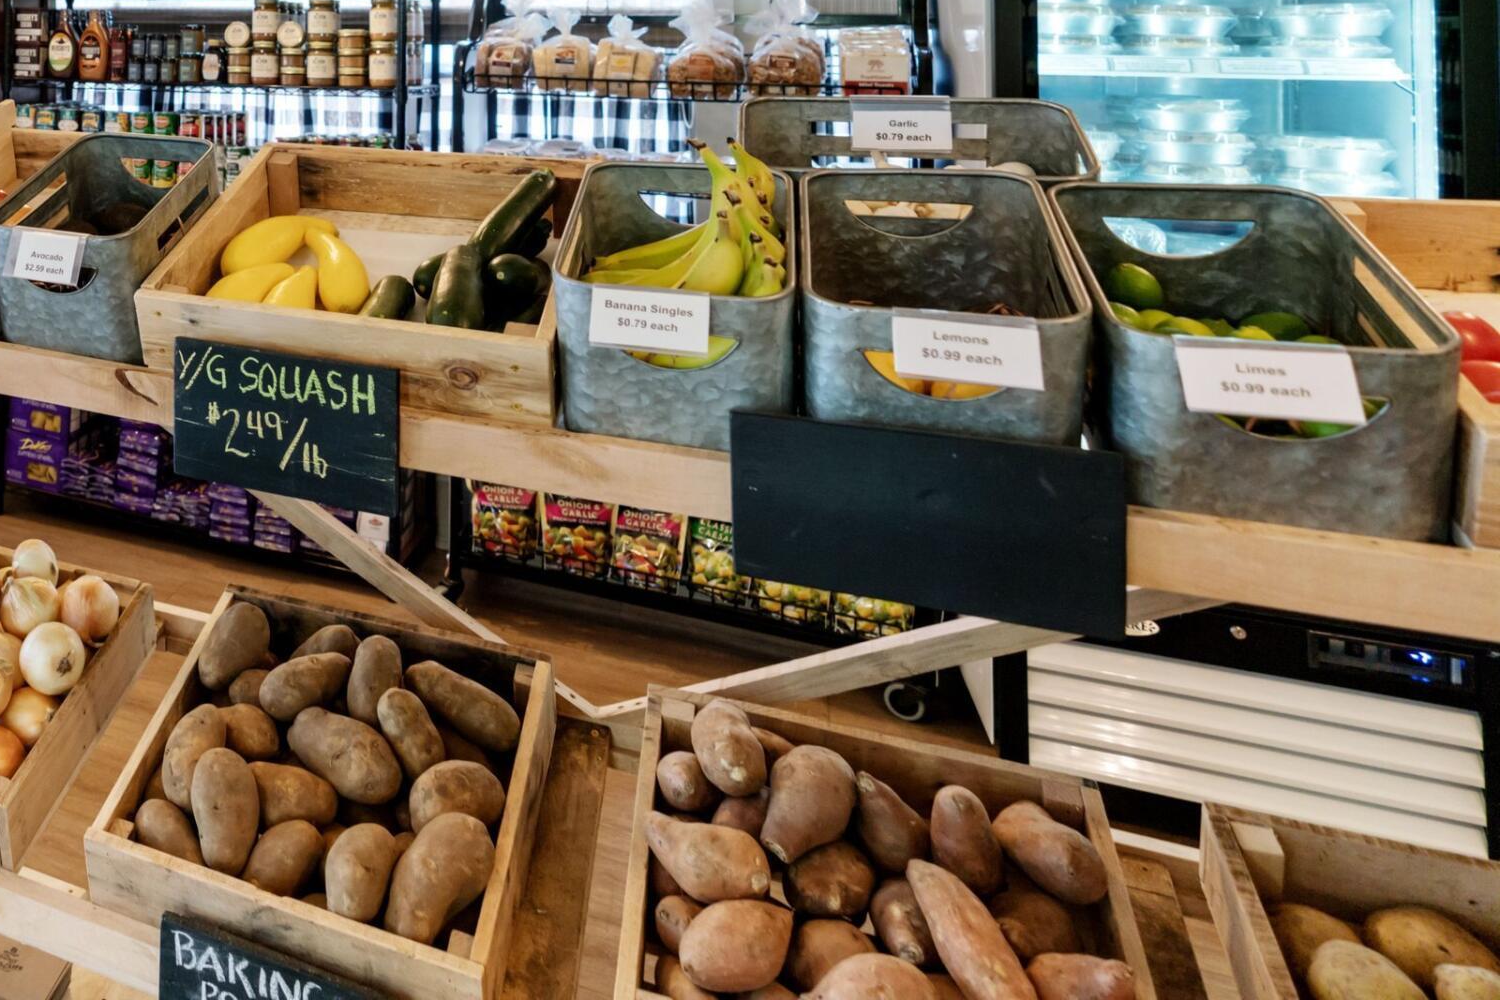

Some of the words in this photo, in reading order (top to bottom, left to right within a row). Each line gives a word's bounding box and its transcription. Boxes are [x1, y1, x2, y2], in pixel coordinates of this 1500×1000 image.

[889, 119, 918, 129] Garlic
[876, 132, 904, 142] $0.79
[906, 133, 932, 142] each
[30, 250, 64, 262] Avocado
[24, 263, 45, 272] $2.59
[45, 266, 64, 275] each
[604, 299, 647, 313] Banana
[650, 304, 693, 317] Singles
[617, 317, 647, 329] $0.79
[650, 322, 678, 333] each
[933, 331, 989, 346] Lemons
[921, 347, 961, 361] $0.99
[966, 353, 1003, 366] each
[1235, 363, 1287, 377] Limes
[178, 346, 228, 390] Y/G
[239, 356, 376, 416] SQUASH
[1220, 380, 1265, 394] $0.99
[1270, 386, 1312, 398] each
[482, 484, 514, 496] ONION
[485, 493, 521, 505] GARLIC
[557, 499, 592, 511] ONION
[560, 507, 598, 520] GARLIC
[623, 509, 657, 523] ONION
[625, 518, 662, 531] GARLIC
[700, 518, 732, 534] CLASSI
